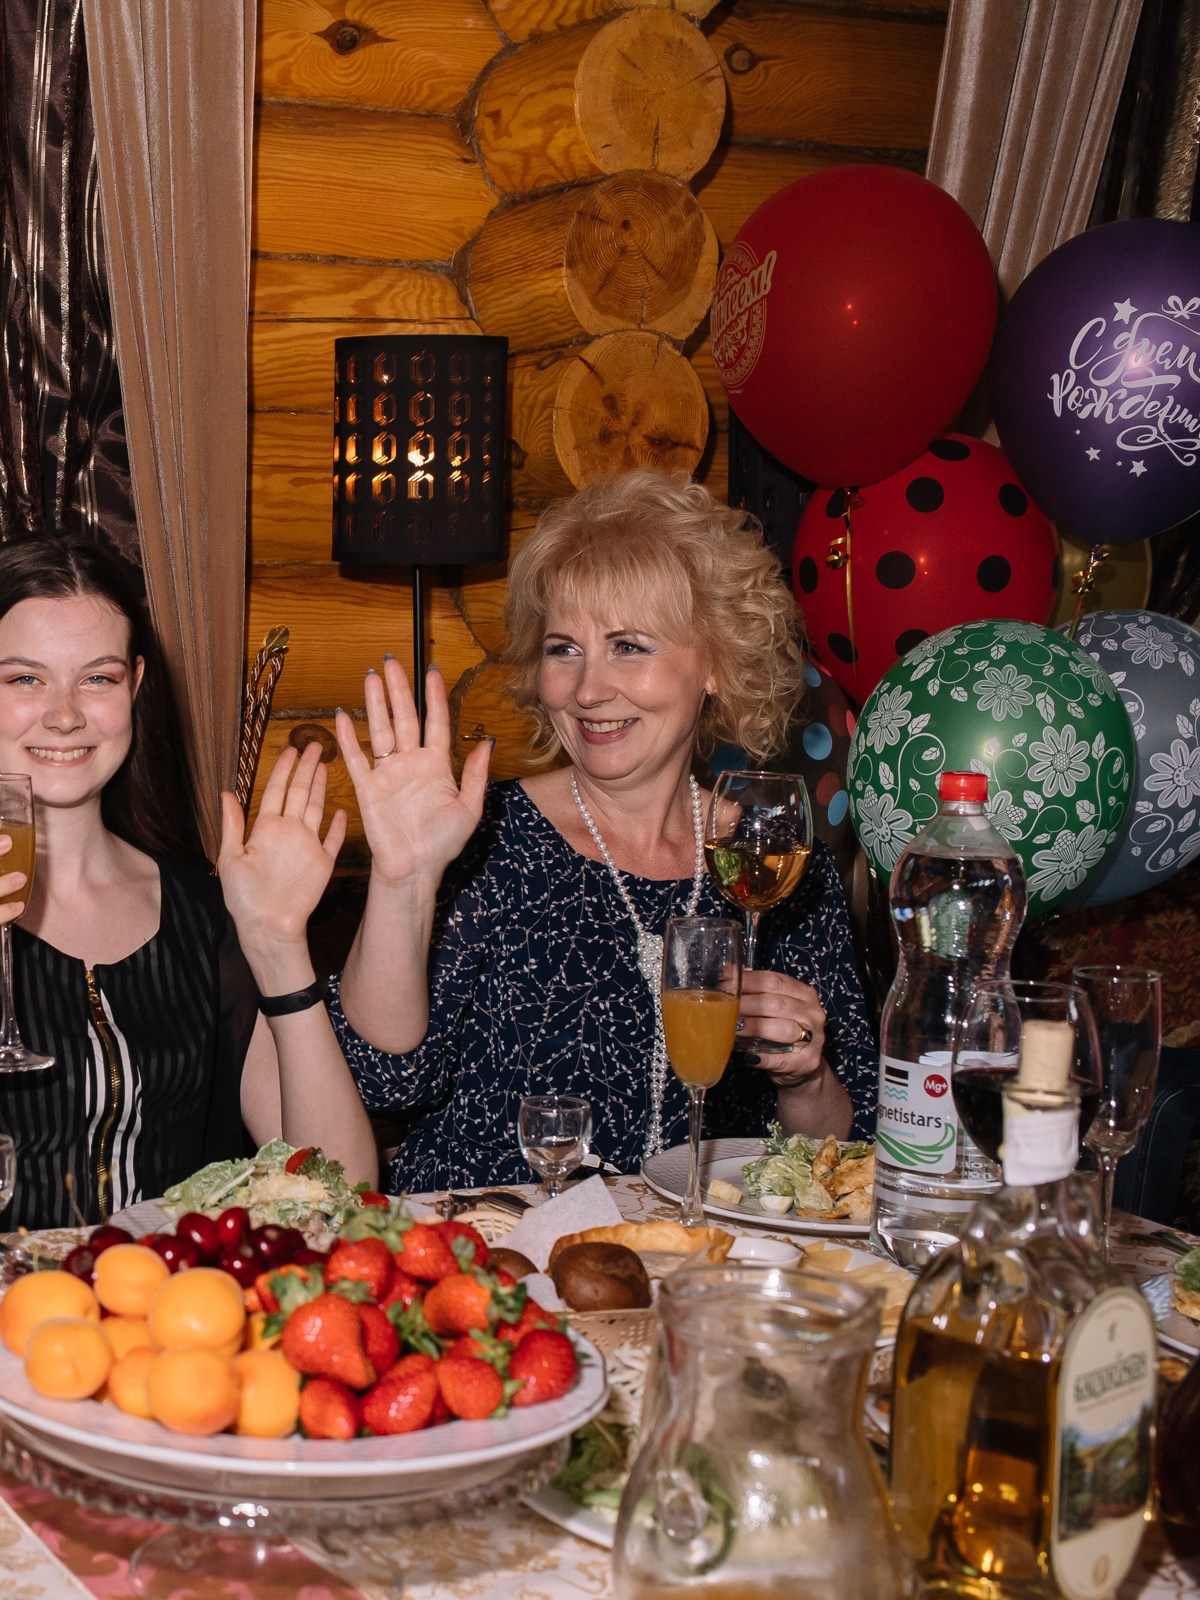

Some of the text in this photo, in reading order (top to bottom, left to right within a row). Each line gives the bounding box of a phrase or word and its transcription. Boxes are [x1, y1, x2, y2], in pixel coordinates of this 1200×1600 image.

[1069, 317, 1107, 370] С
[1047, 366, 1200, 433] Рождени
[925, 1080, 948, 1093] Mg+
